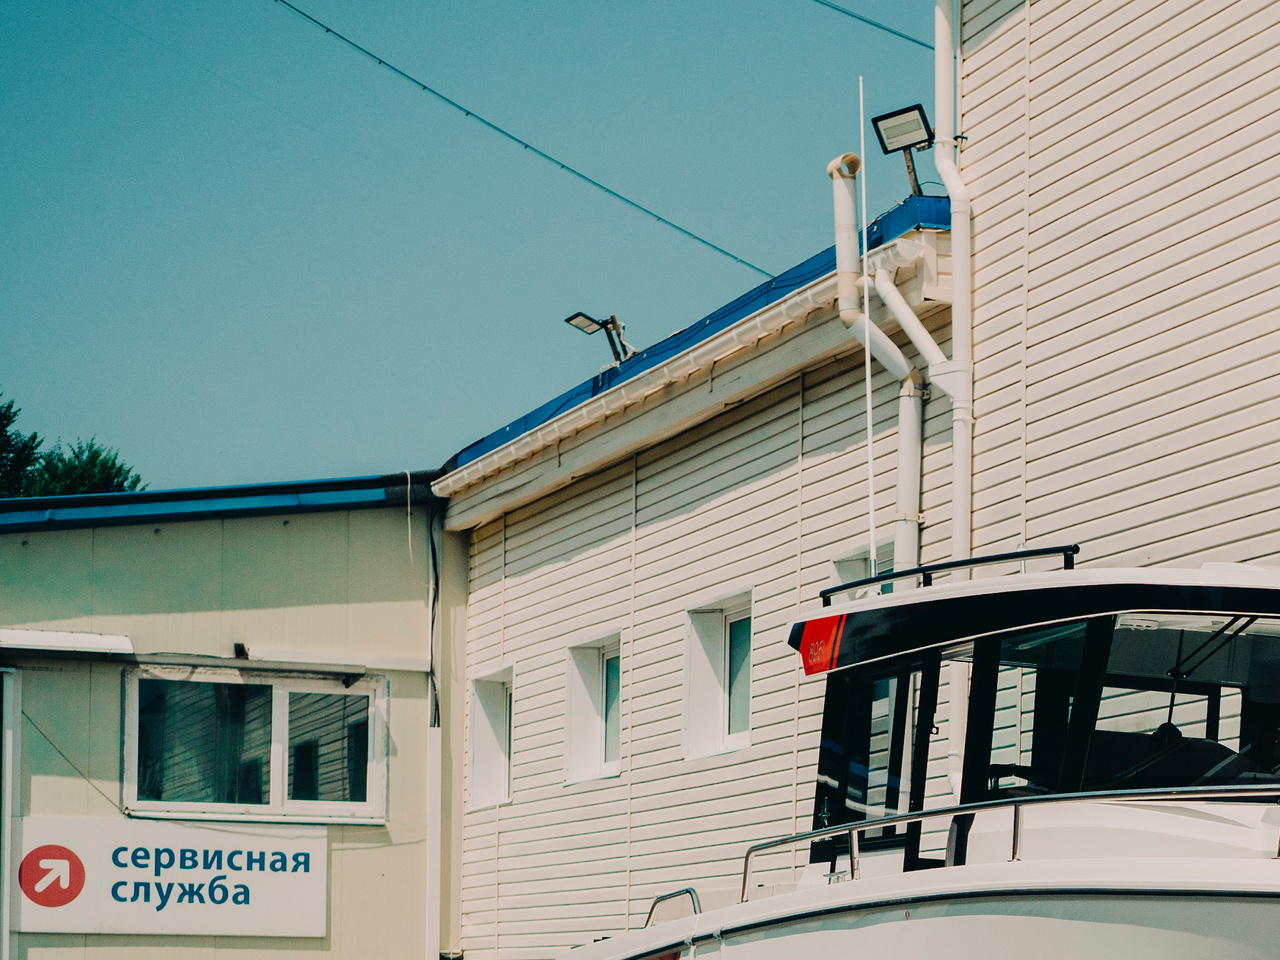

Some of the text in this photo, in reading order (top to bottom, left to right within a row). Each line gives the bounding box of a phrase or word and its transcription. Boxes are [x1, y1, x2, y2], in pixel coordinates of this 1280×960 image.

[808, 640, 824, 663] 895
[111, 846, 310, 876] сервисная
[111, 875, 251, 911] служба
